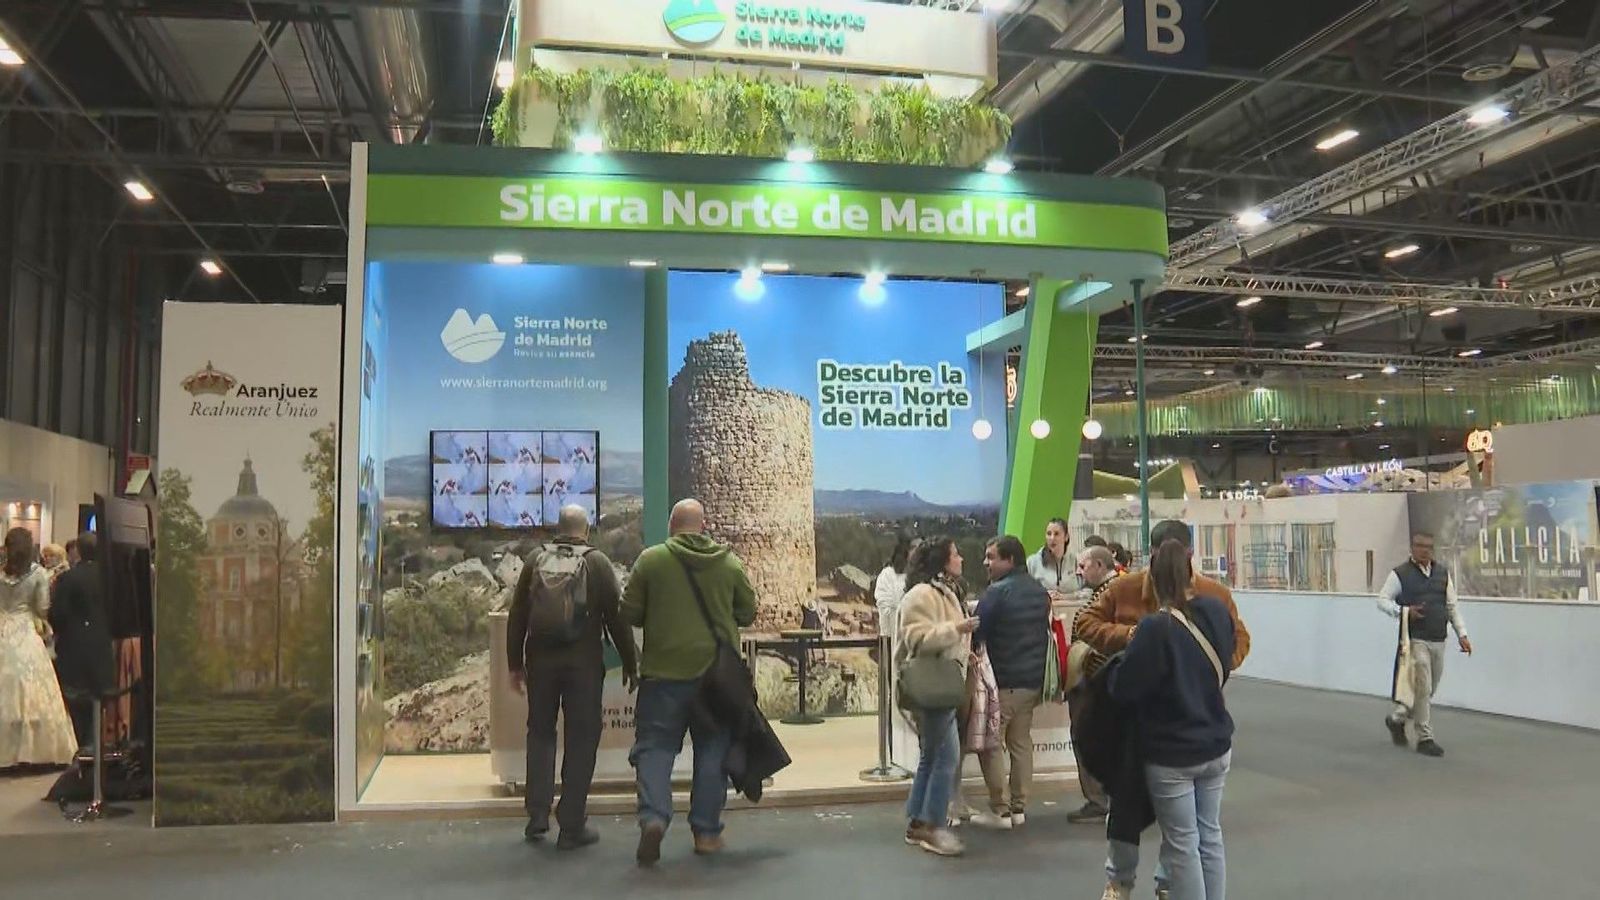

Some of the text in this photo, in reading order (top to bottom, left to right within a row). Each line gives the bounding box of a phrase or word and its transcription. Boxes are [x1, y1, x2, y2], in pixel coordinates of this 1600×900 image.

[735, 0, 865, 30] Sierra Norte
[1145, 0, 1186, 54] B
[736, 25, 845, 53] de Madrid
[500, 184, 1037, 238] Sierra Norte de Madrid
[514, 316, 607, 330] Sierra Norte
[514, 333, 592, 346] de Madrid
[440, 375, 607, 391] www.sierranortemadrid.org
[820, 362, 962, 384] Descubre la
[236, 383, 318, 400] Aranjuez
[821, 385, 968, 406] Sierra Norte
[189, 400, 271, 417] Realmente
[822, 407, 948, 427] de Madrid
[1325, 464, 1368, 478] CASTILLA
[1369, 463, 1375, 473] Y
